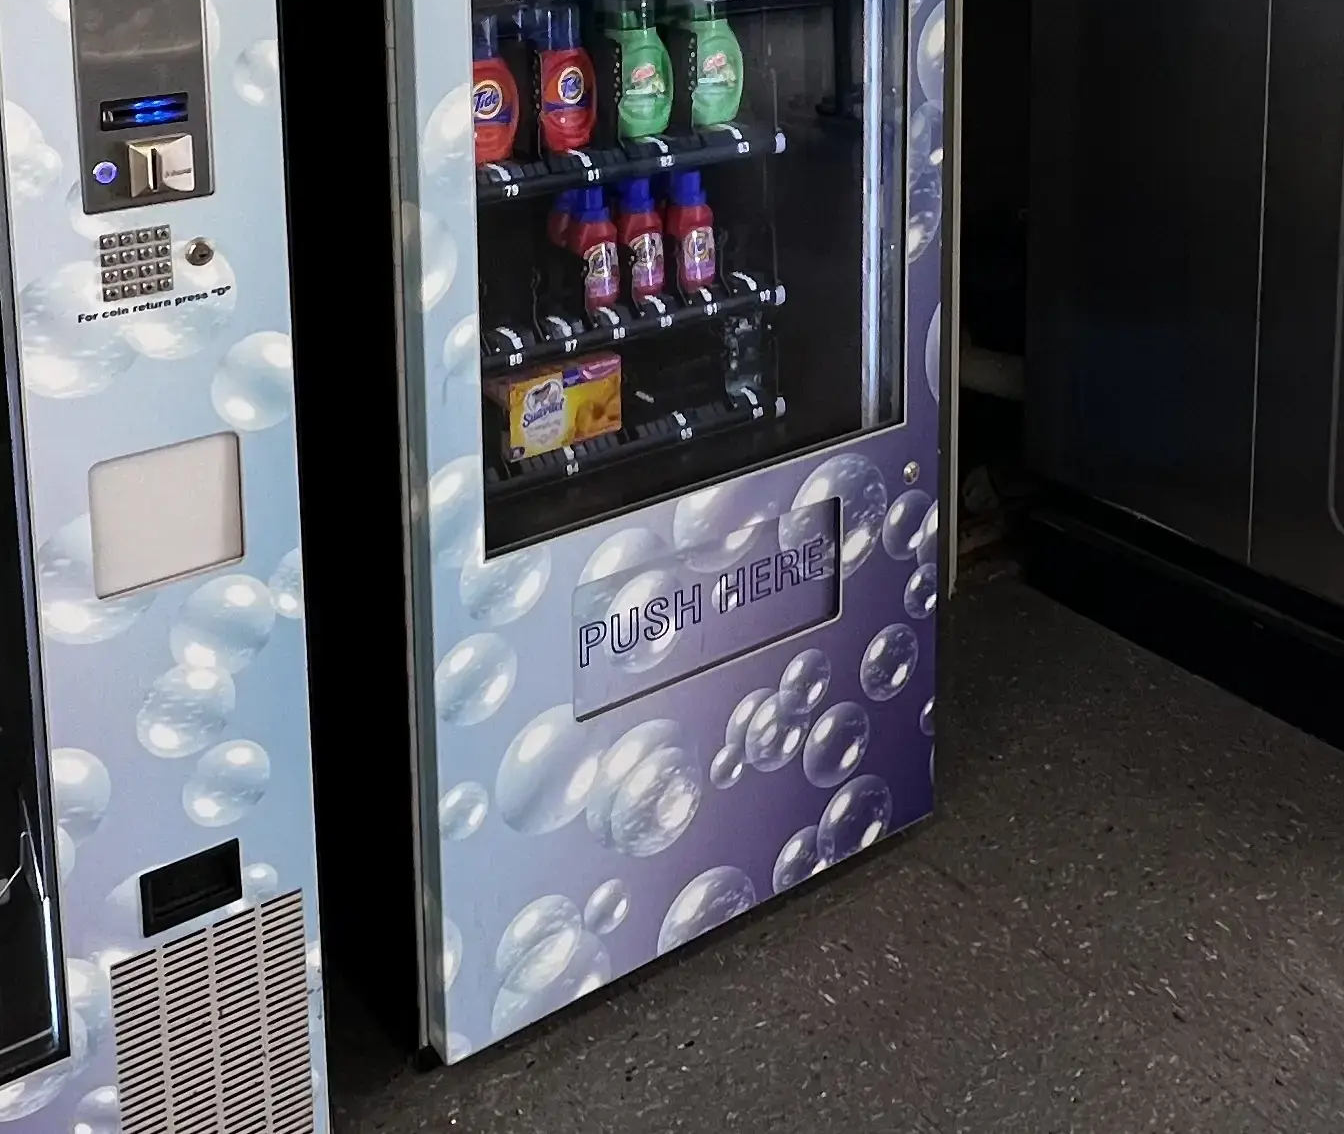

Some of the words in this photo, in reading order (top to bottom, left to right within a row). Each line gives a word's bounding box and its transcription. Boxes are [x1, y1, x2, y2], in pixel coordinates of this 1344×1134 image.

[473, 90, 500, 112] Tide
[504, 184, 519, 198] 79
[77, 312, 99, 323] For
[102, 306, 129, 319] coin
[133, 298, 172, 313] return
[175, 291, 208, 306] press
[578, 583, 702, 668] PUSH
[719, 538, 824, 615] HERE
